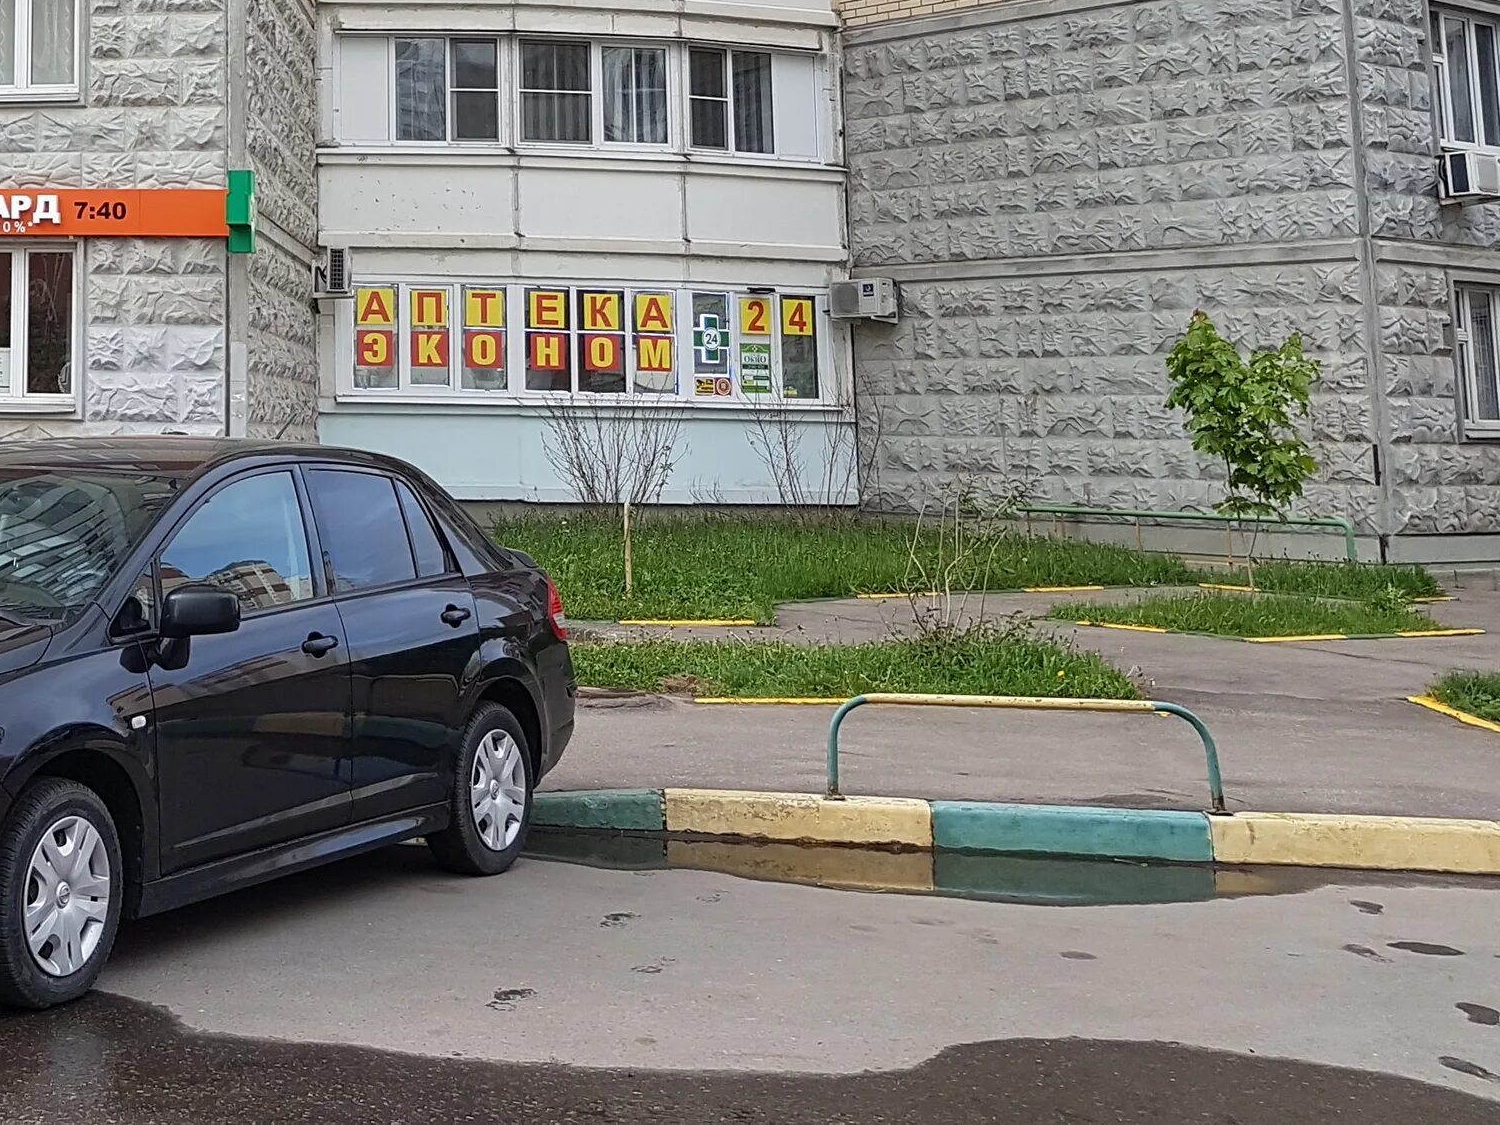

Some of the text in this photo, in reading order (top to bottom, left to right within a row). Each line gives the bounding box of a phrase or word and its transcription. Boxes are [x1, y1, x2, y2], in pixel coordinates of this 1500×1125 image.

[74, 201, 127, 220] 7:40
[360, 291, 807, 332] АПТЕКА 24
[363, 334, 670, 368] ЭКОНОМ
[705, 333, 718, 344] 24
